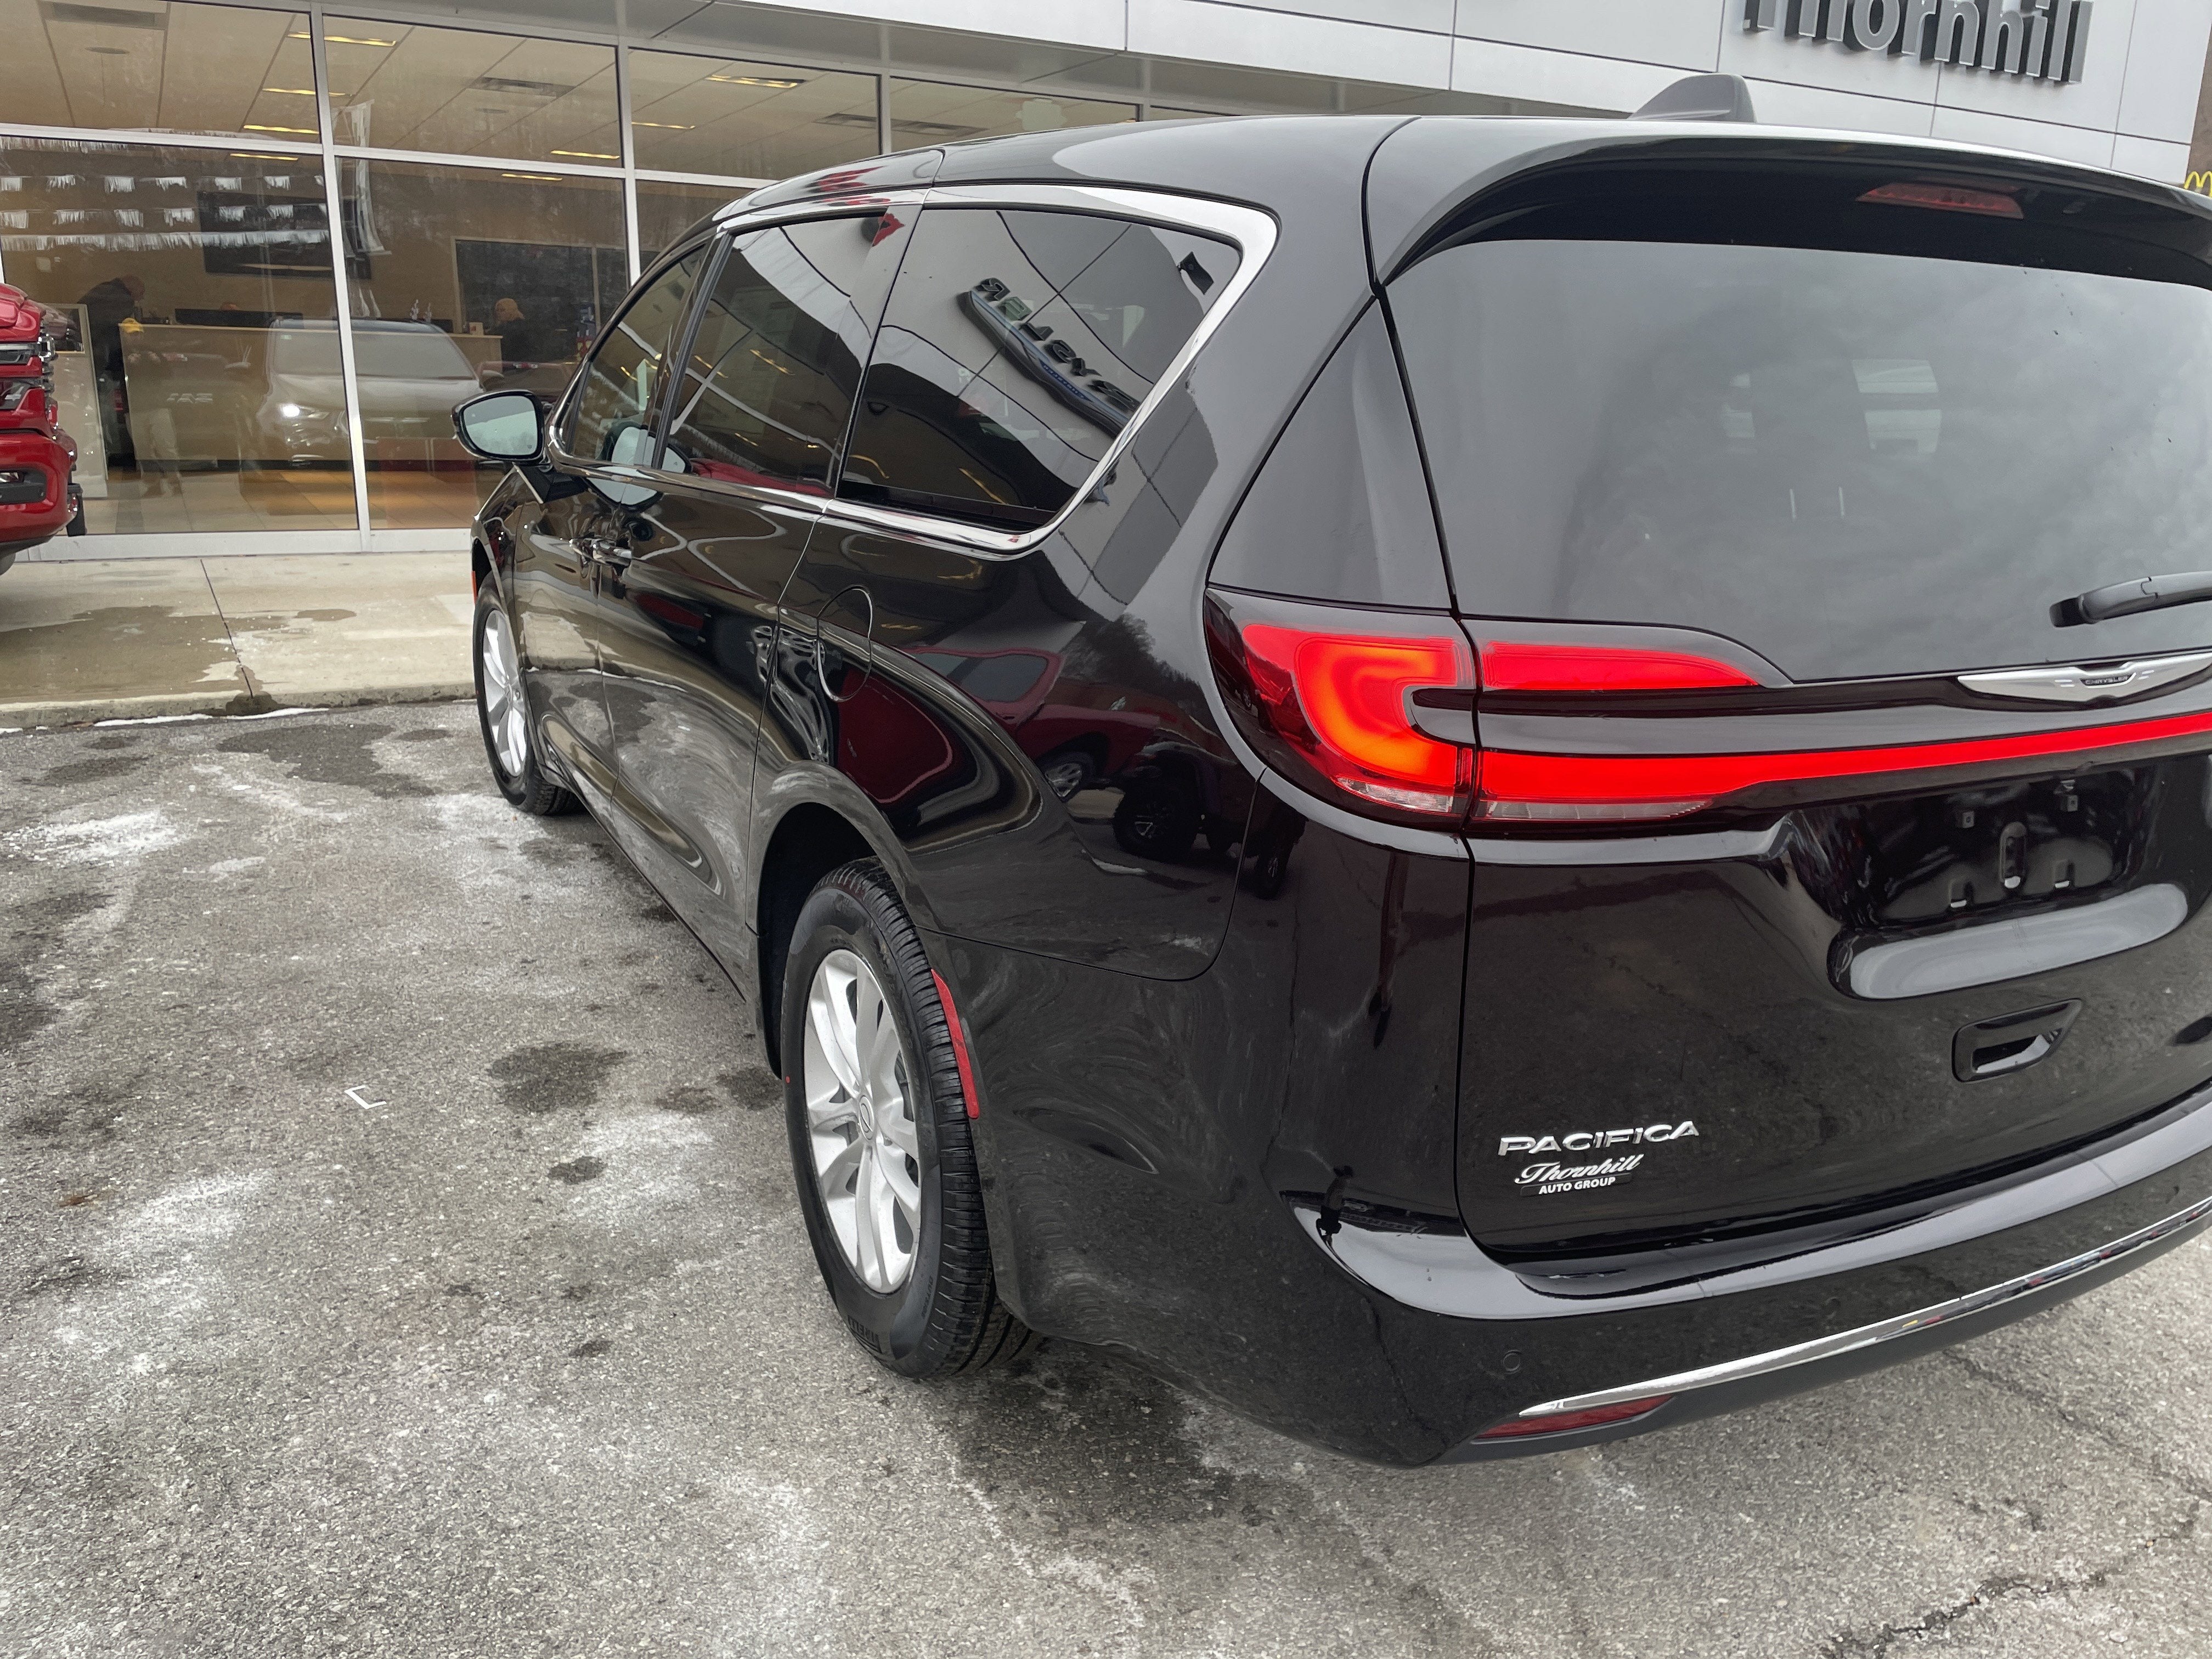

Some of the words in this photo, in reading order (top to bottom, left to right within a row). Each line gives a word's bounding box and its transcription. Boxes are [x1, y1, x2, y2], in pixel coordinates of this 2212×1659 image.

[1498, 1121, 1699, 1156] PACIFICA
[1514, 1154, 1644, 1184] Thornhill
[1538, 1181, 1572, 1195] AUTO
[1574, 1176, 1616, 1191] GROUP
